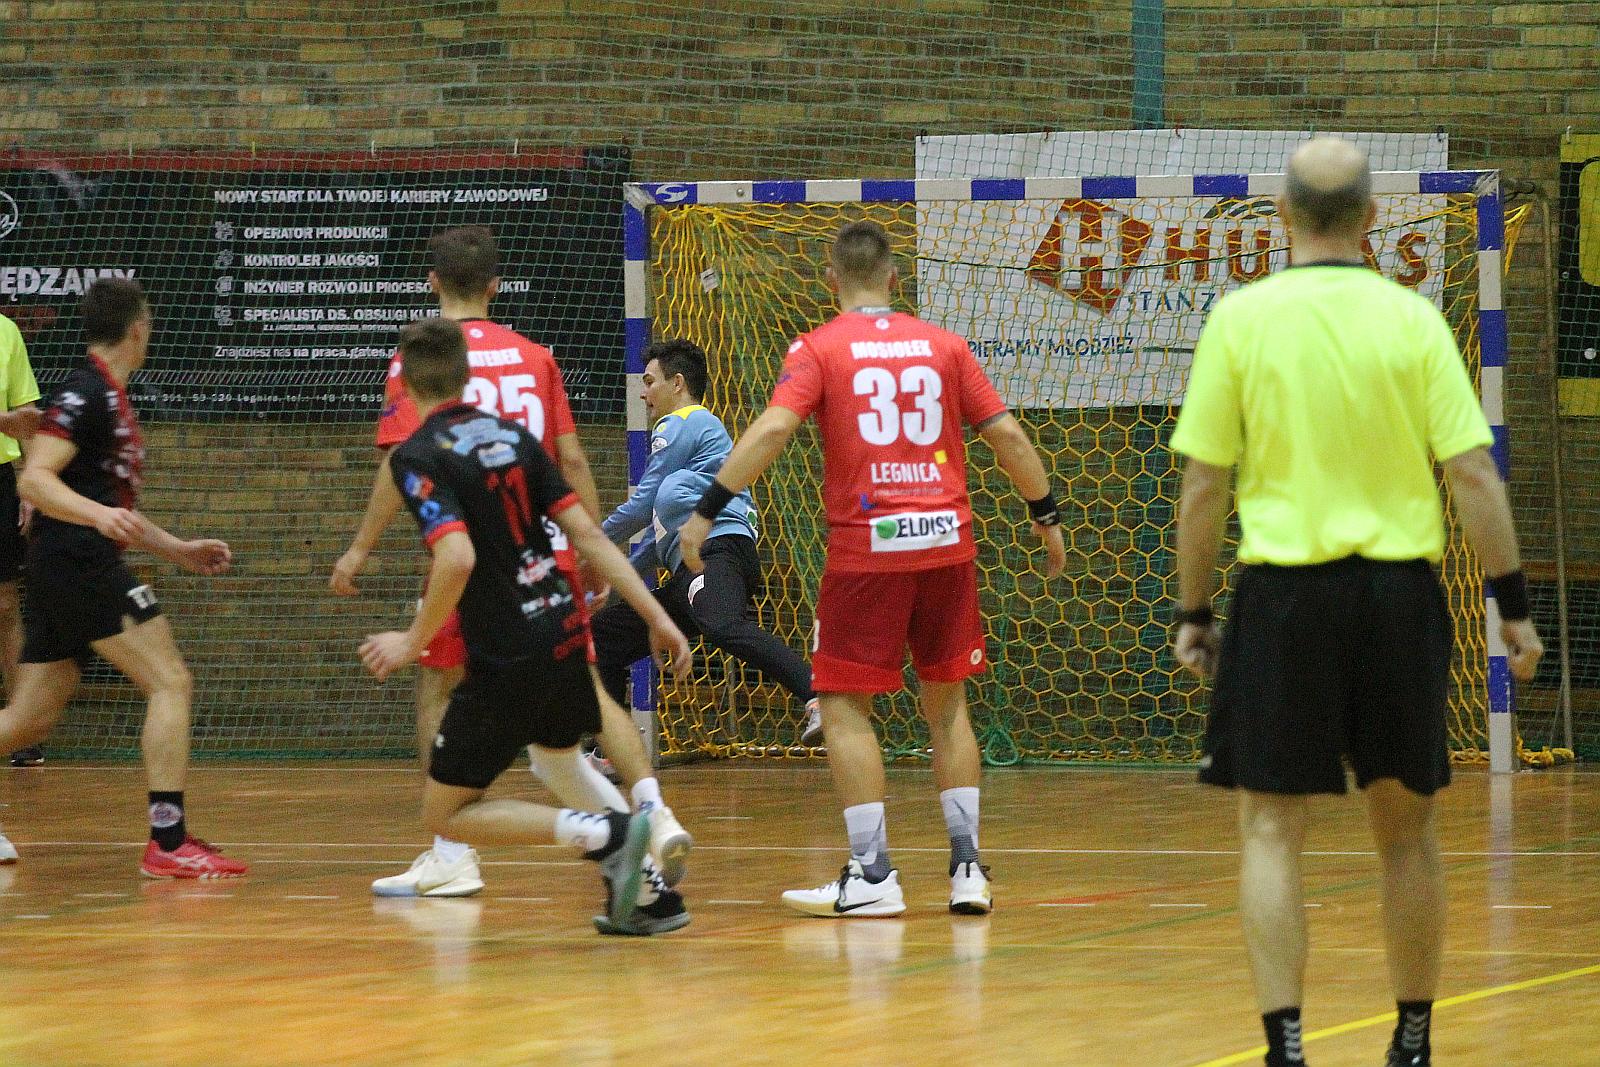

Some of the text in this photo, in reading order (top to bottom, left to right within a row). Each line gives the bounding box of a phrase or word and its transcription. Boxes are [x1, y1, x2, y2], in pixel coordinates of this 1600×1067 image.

[214, 188, 548, 203] NOWY START DLA TWOJEJ KARIERY ZAWODOWEJ
[243, 227, 388, 240] OPERATOR PRODUKCJI
[243, 251, 380, 267] KONTROLER JAKOŚCI
[1164, 226, 1430, 286] HUS
[243, 279, 305, 294] INŻYNIER
[308, 281, 373, 294] ROZWOJU
[327, 308, 351, 321] DS.
[214, 346, 271, 360] Znajdziesz
[273, 348, 291, 358] nas
[293, 348, 309, 358] na
[853, 365, 944, 446] 33
[870, 462, 942, 484] LEGNICA
[894, 515, 954, 539] ELDISY
